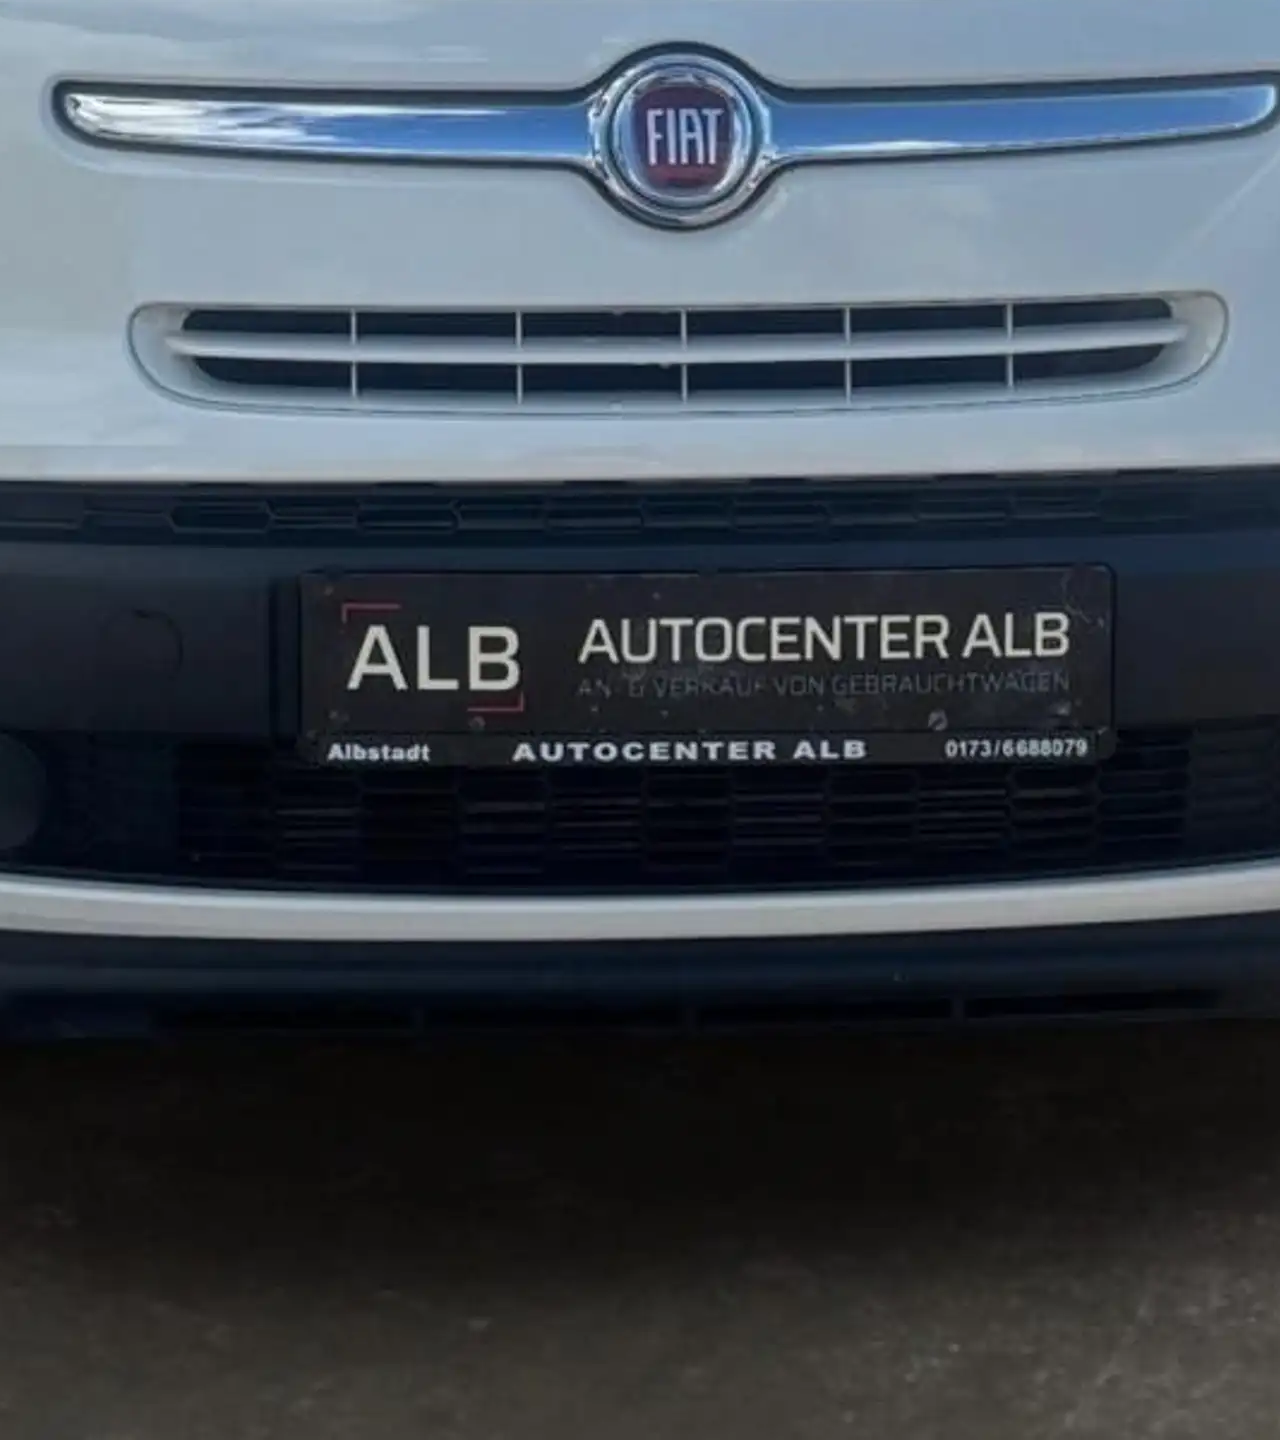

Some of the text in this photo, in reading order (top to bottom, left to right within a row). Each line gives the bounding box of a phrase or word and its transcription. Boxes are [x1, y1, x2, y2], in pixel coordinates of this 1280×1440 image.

[646, 107, 724, 167] FIAT
[346, 624, 521, 692] ALB
[578, 611, 1071, 664] AUTOCENTER ALB
[771, 673, 825, 697] VON
[326, 741, 431, 763] Albstadt
[513, 740, 778, 763] AUTOCENTER
[793, 739, 868, 761] ALB
